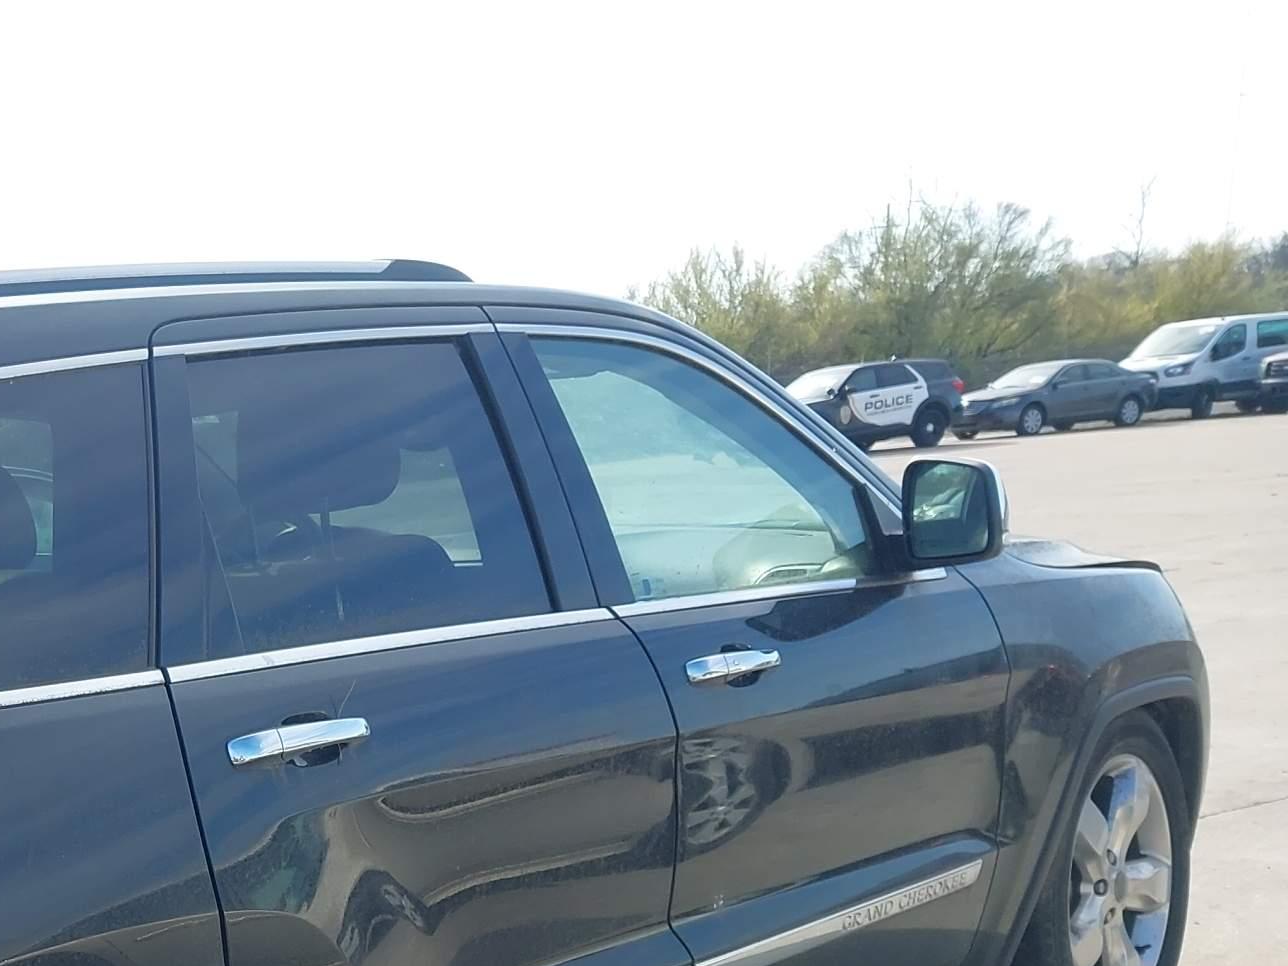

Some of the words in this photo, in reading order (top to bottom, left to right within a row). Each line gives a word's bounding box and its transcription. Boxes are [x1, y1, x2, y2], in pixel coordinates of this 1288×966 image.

[864, 395, 913, 412] POLICE
[841, 900, 894, 930] GRAND
[898, 872, 968, 909] CHEROKEE
